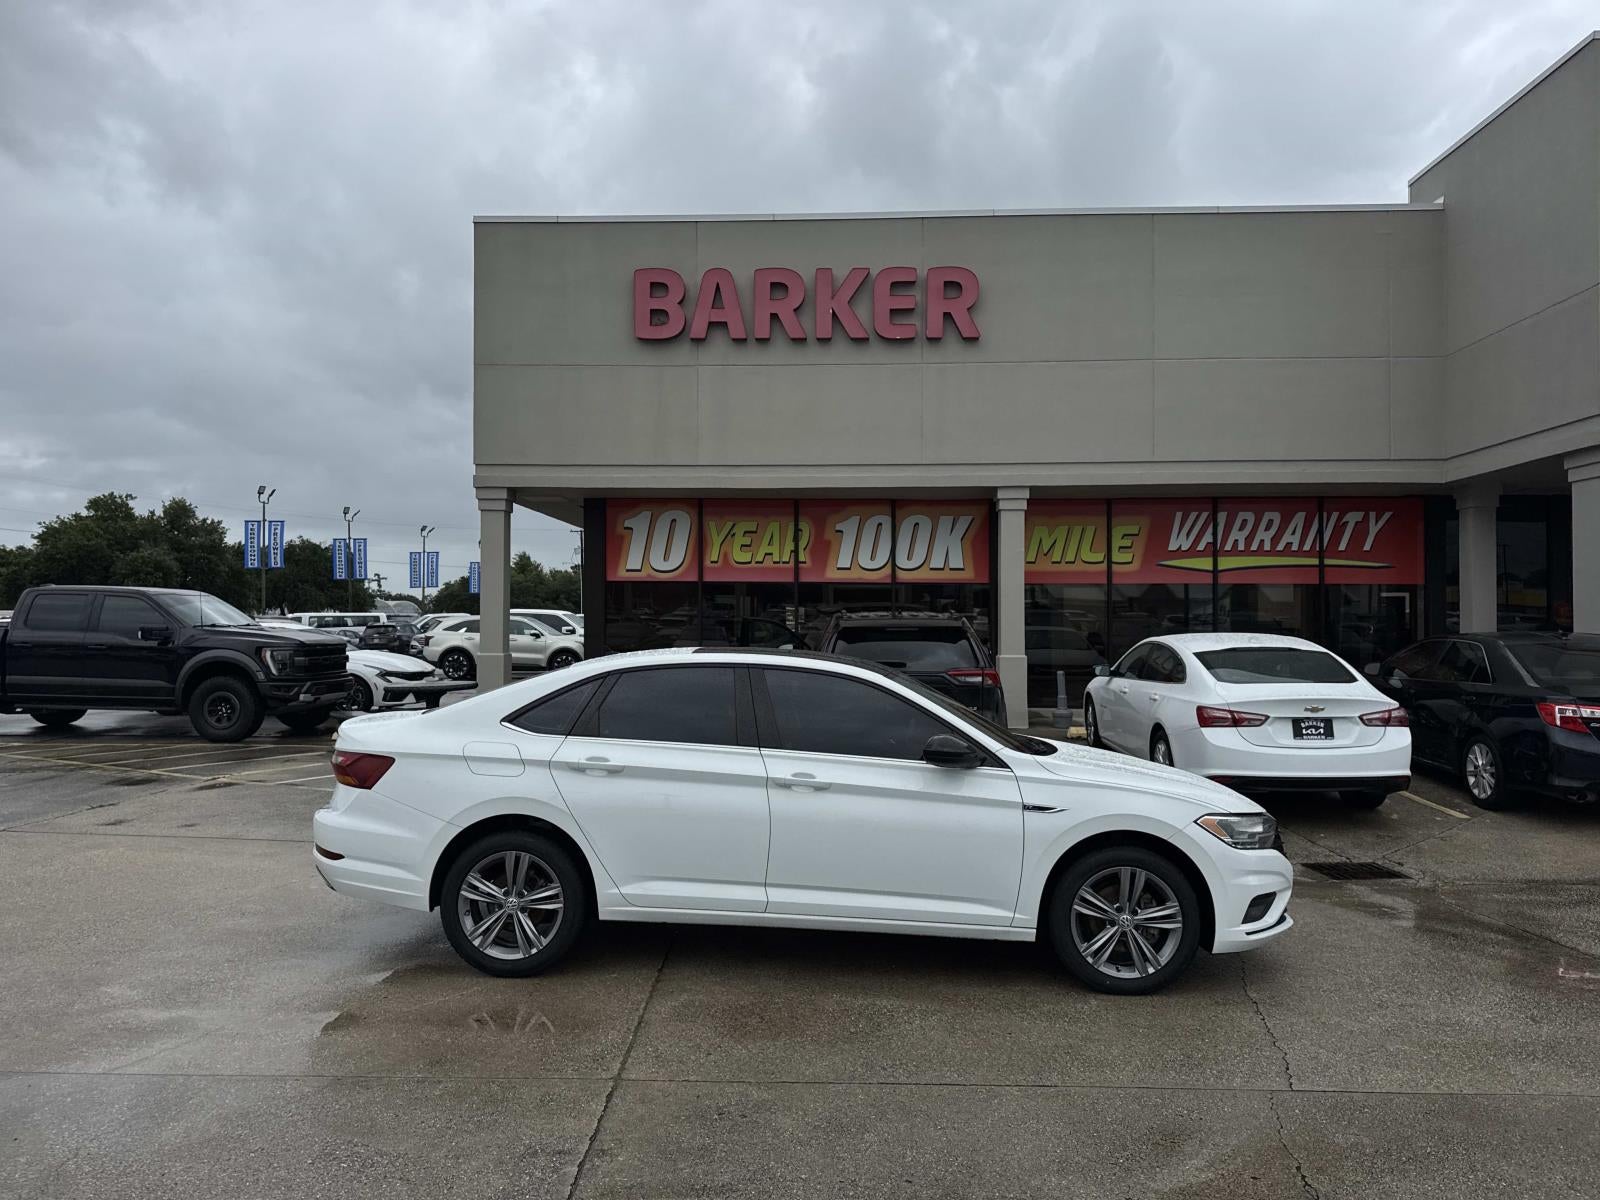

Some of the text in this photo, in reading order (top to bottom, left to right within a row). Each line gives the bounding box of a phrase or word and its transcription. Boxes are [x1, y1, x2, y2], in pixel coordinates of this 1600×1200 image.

[633, 266, 981, 341] BARKER
[623, 509, 1395, 572] 10 YEAR 100K MILE WARRANTY
